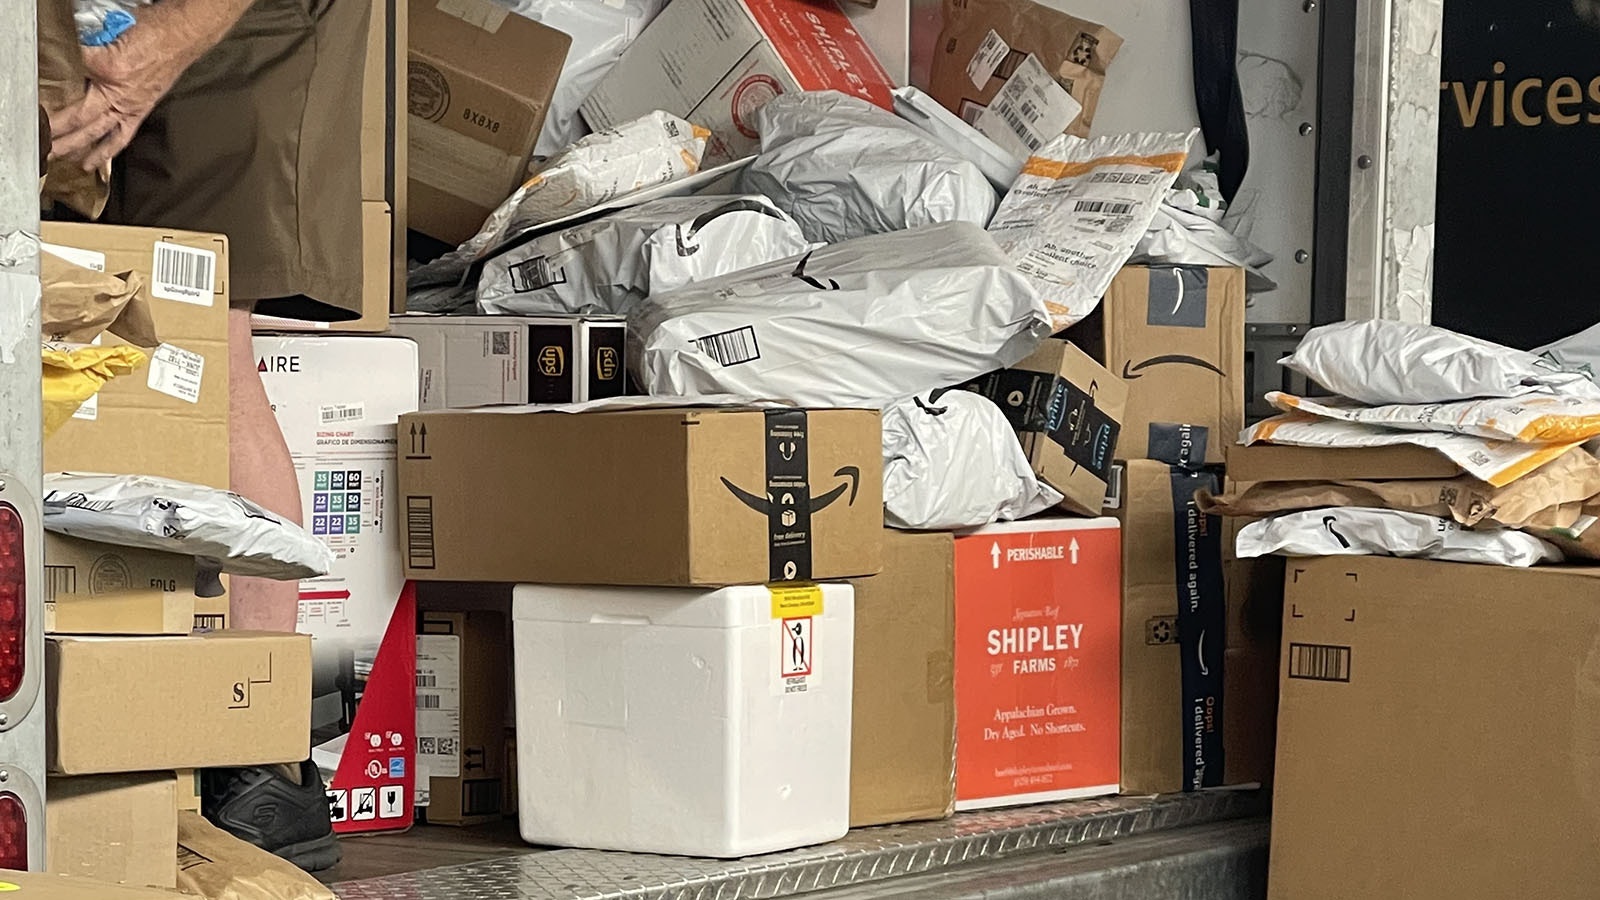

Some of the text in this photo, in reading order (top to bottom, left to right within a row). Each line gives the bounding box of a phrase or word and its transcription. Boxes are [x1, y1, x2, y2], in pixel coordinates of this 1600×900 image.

[804, 11, 872, 99] SHIPLEY
[462, 108, 501, 133] 8X8X8
[257, 356, 300, 372] AIRE
[542, 349, 556, 374] ups
[603, 350, 616, 377] ups
[1048, 383, 1065, 431] prime
[1096, 423, 1112, 470] prime
[317, 472, 360, 482] 35 50 60
[316, 495, 359, 504] 22 35 50
[315, 517, 358, 526] 22 22 35
[1187, 509, 1199, 569] delivered
[1007, 546, 1065, 562] PERISHABLE
[1187, 572, 1200, 613] again.
[987, 623, 1084, 655] SHIPLEY
[1013, 657, 1056, 675] FARMS
[993, 703, 1077, 723] Appalachian Grown.
[1204, 696, 1215, 733] Oops!
[983, 721, 1086, 742] Dry Aged. No Shortcuts.
[1194, 705, 1205, 766] delivered
